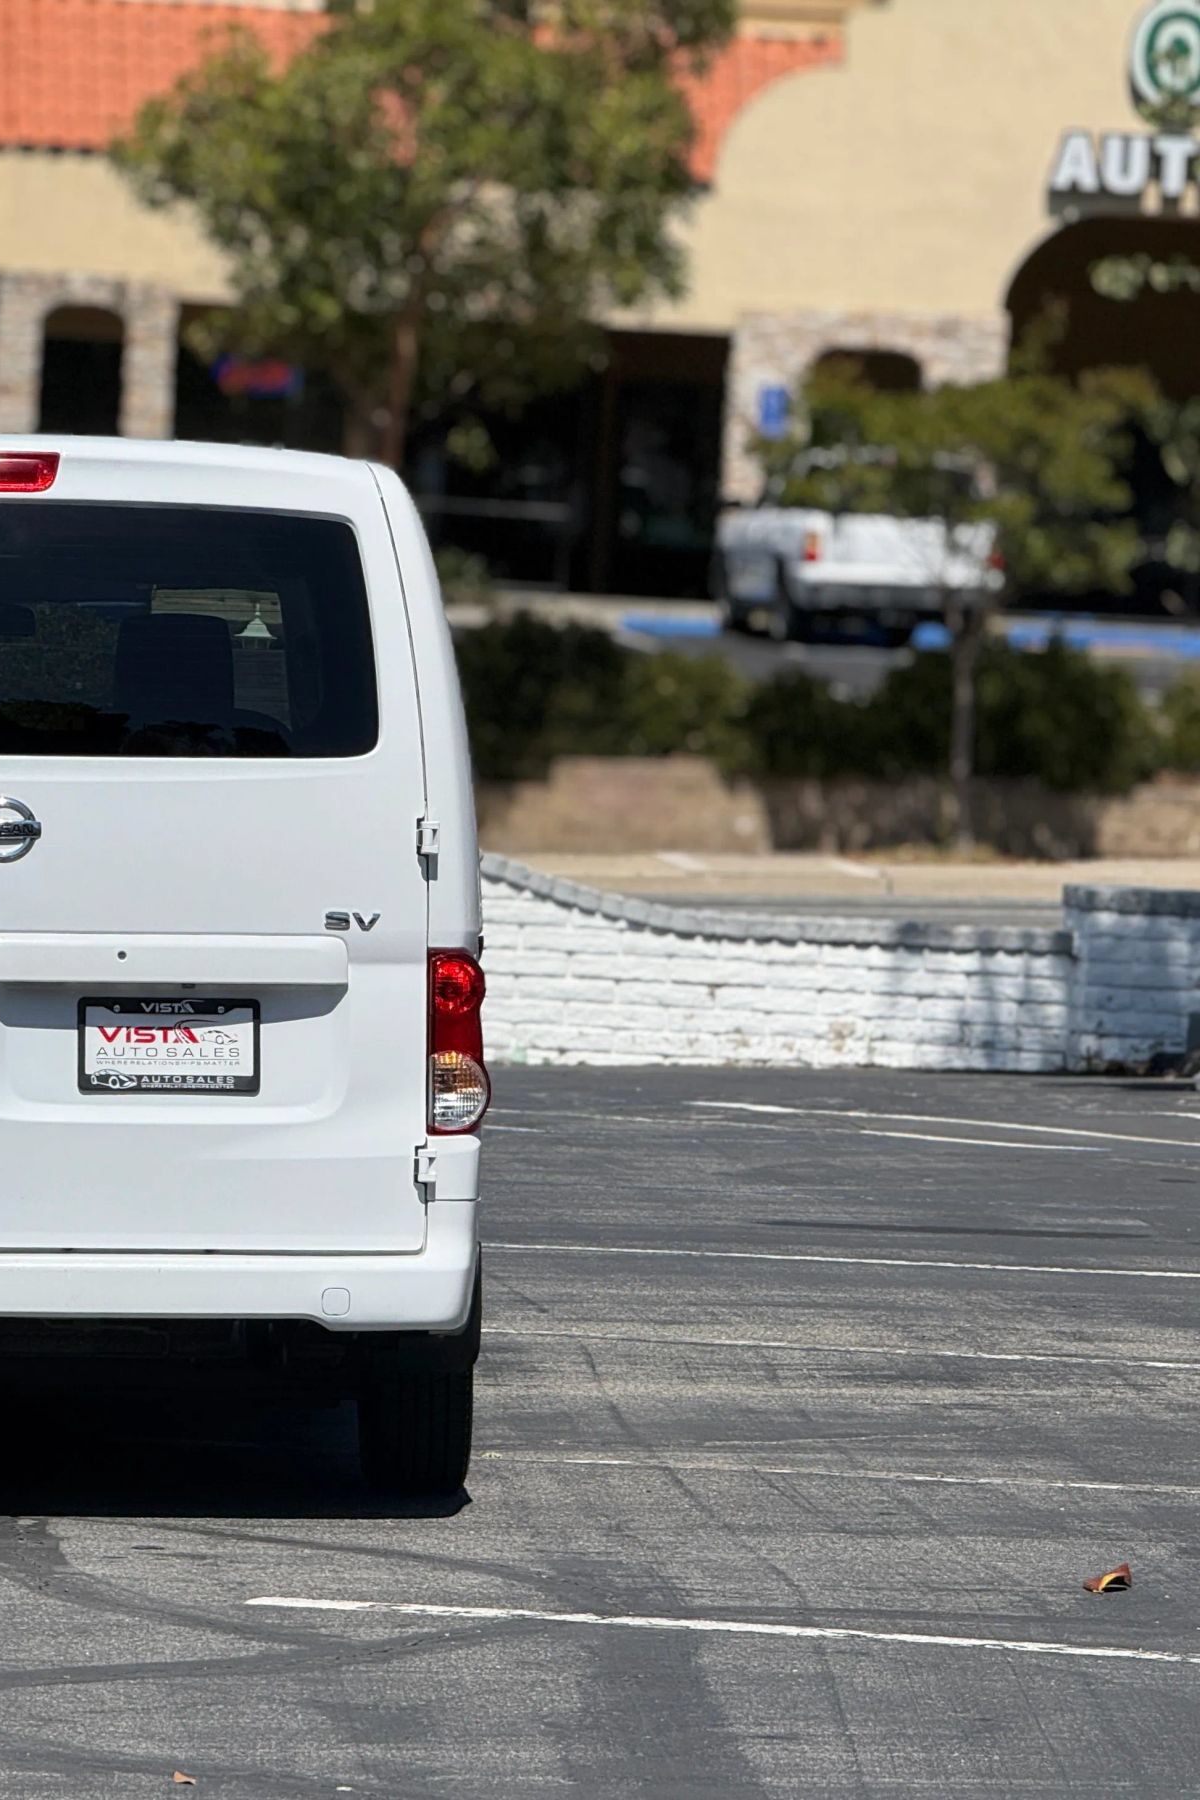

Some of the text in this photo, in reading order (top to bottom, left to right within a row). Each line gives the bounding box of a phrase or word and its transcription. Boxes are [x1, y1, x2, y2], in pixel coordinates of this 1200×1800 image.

[324, 911, 381, 932] SV
[140, 1001, 194, 1013] VISTA
[97, 1025, 200, 1044] VISTA
[96, 1047, 240, 1058] AUTO SALES
[141, 1075, 235, 1084] AUTO SALES
